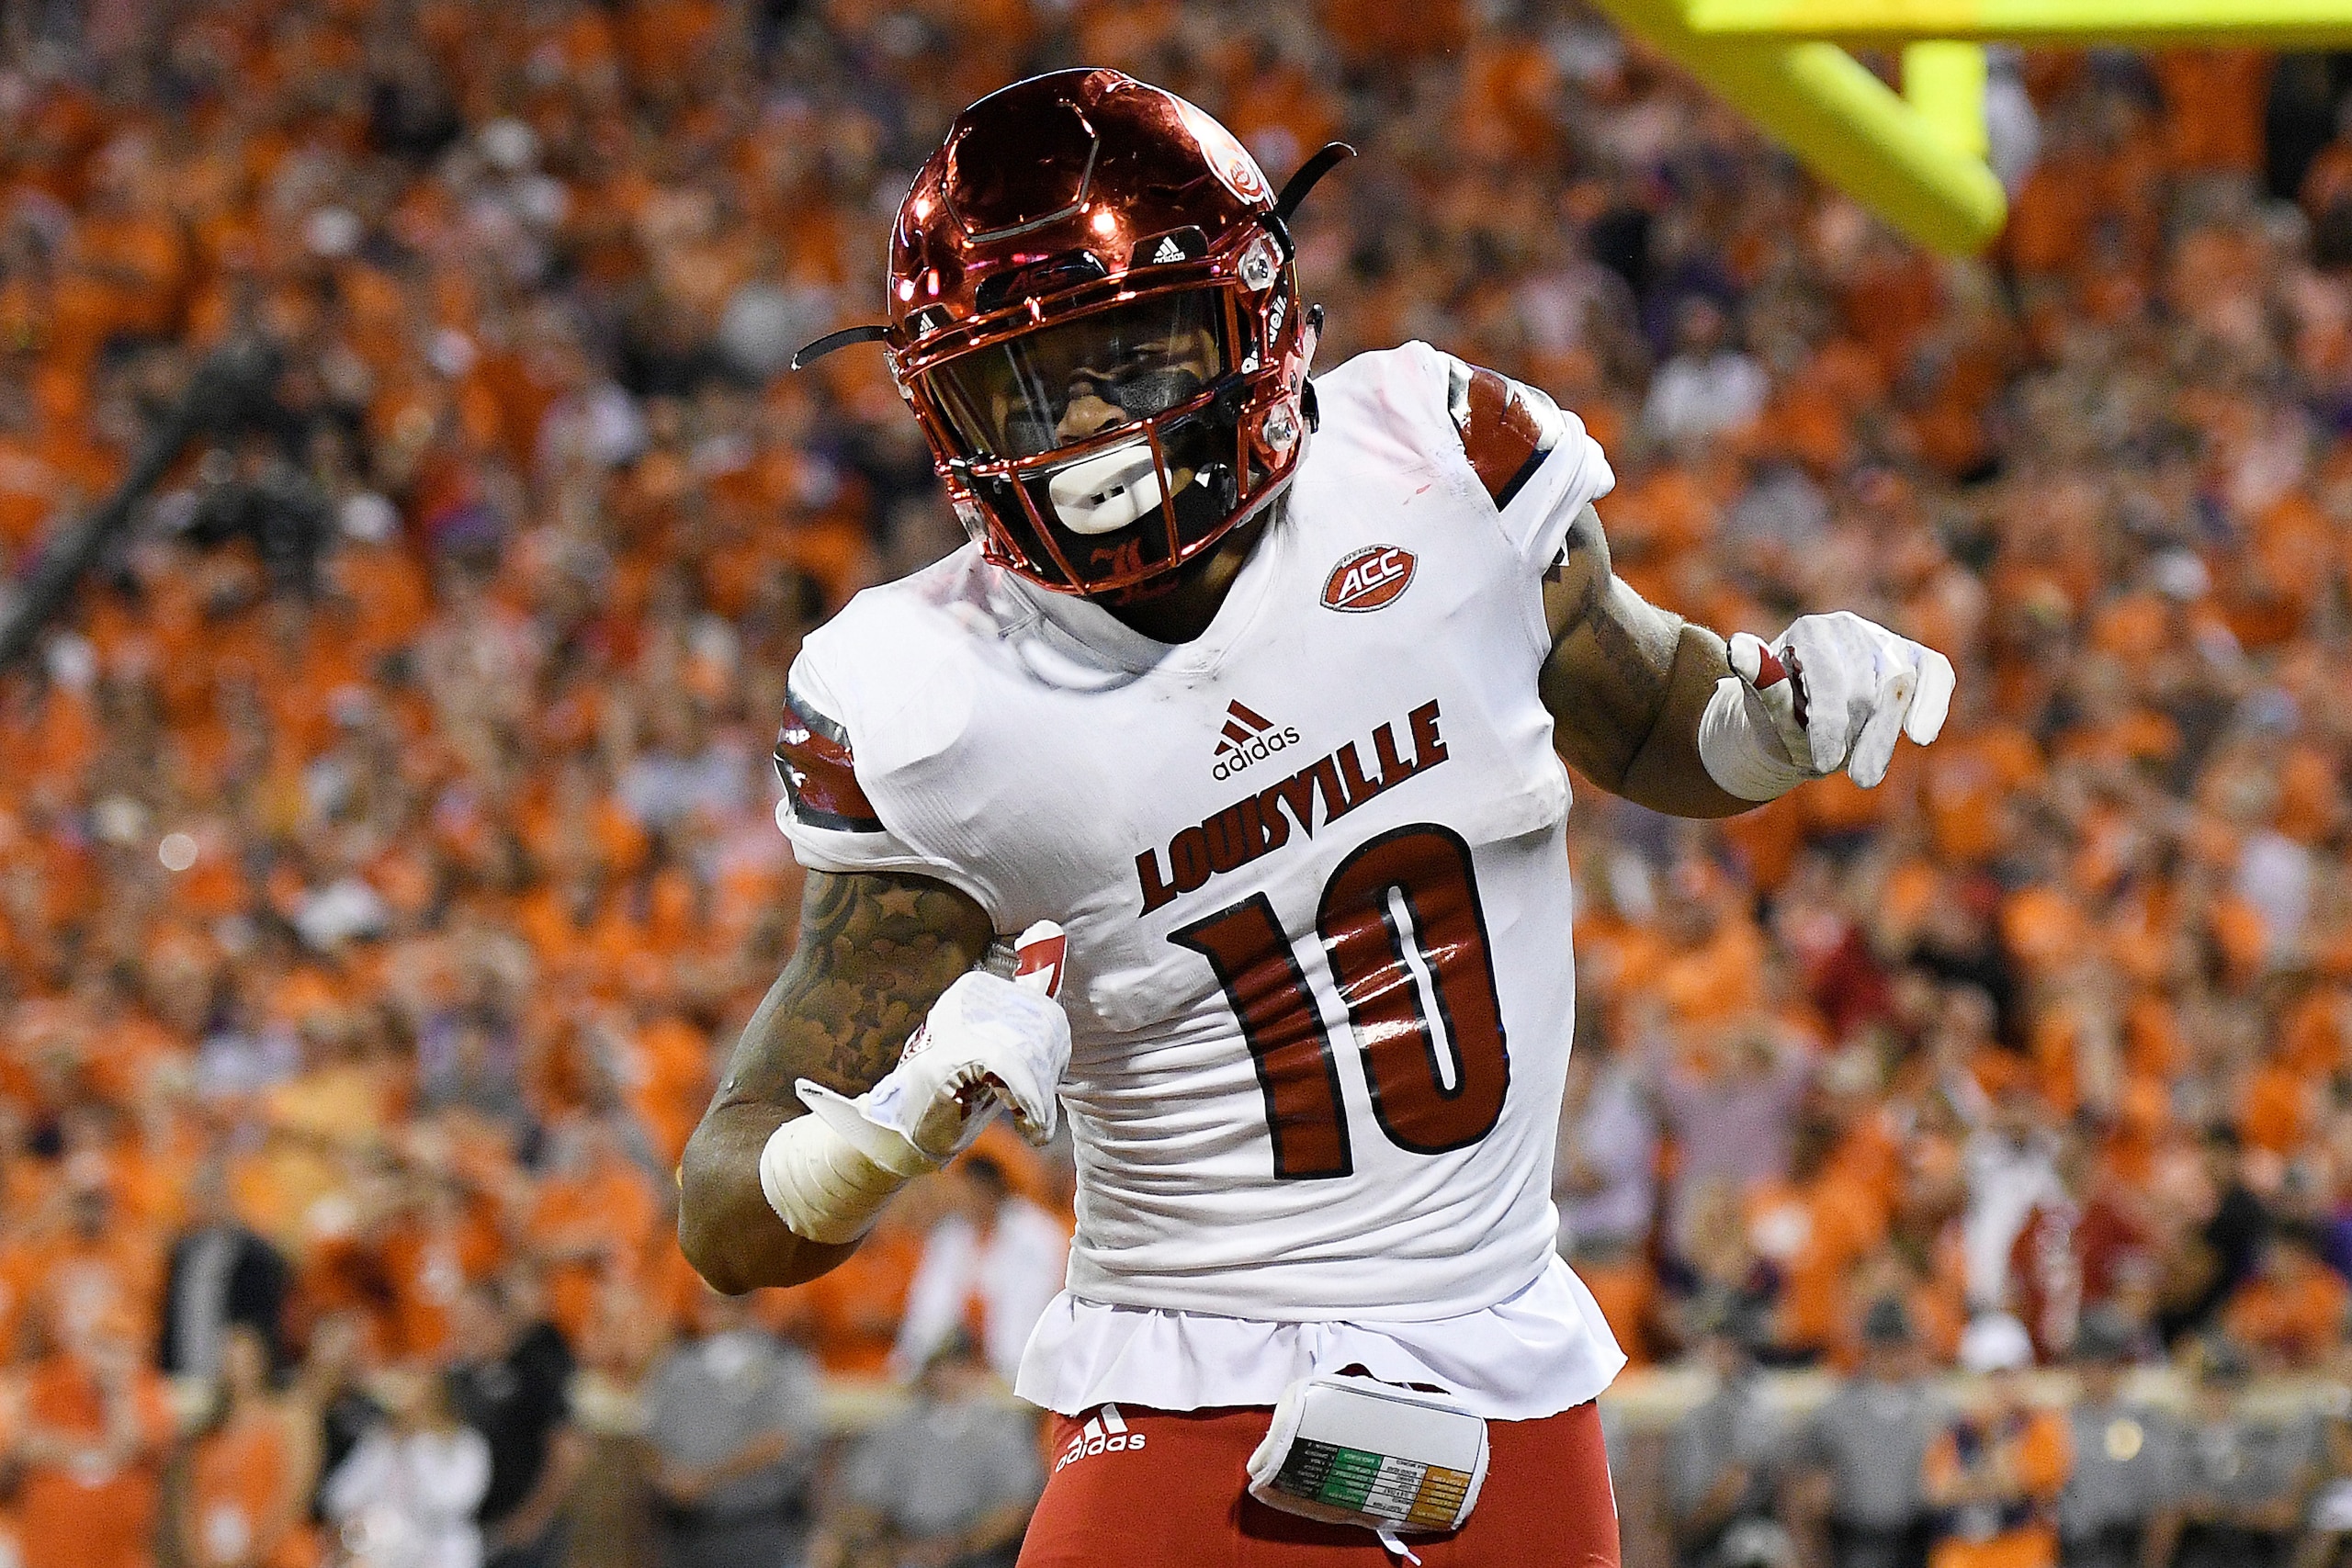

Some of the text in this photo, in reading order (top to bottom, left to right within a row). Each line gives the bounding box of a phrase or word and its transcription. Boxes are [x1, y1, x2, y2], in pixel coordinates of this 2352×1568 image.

[1338, 547, 1404, 601] ACC
[1213, 727, 1301, 781] adidas
[1135, 698, 1449, 919] LOUISVILLE
[1166, 822, 1510, 1180] 10
[1055, 1433, 1147, 1473] adidas
